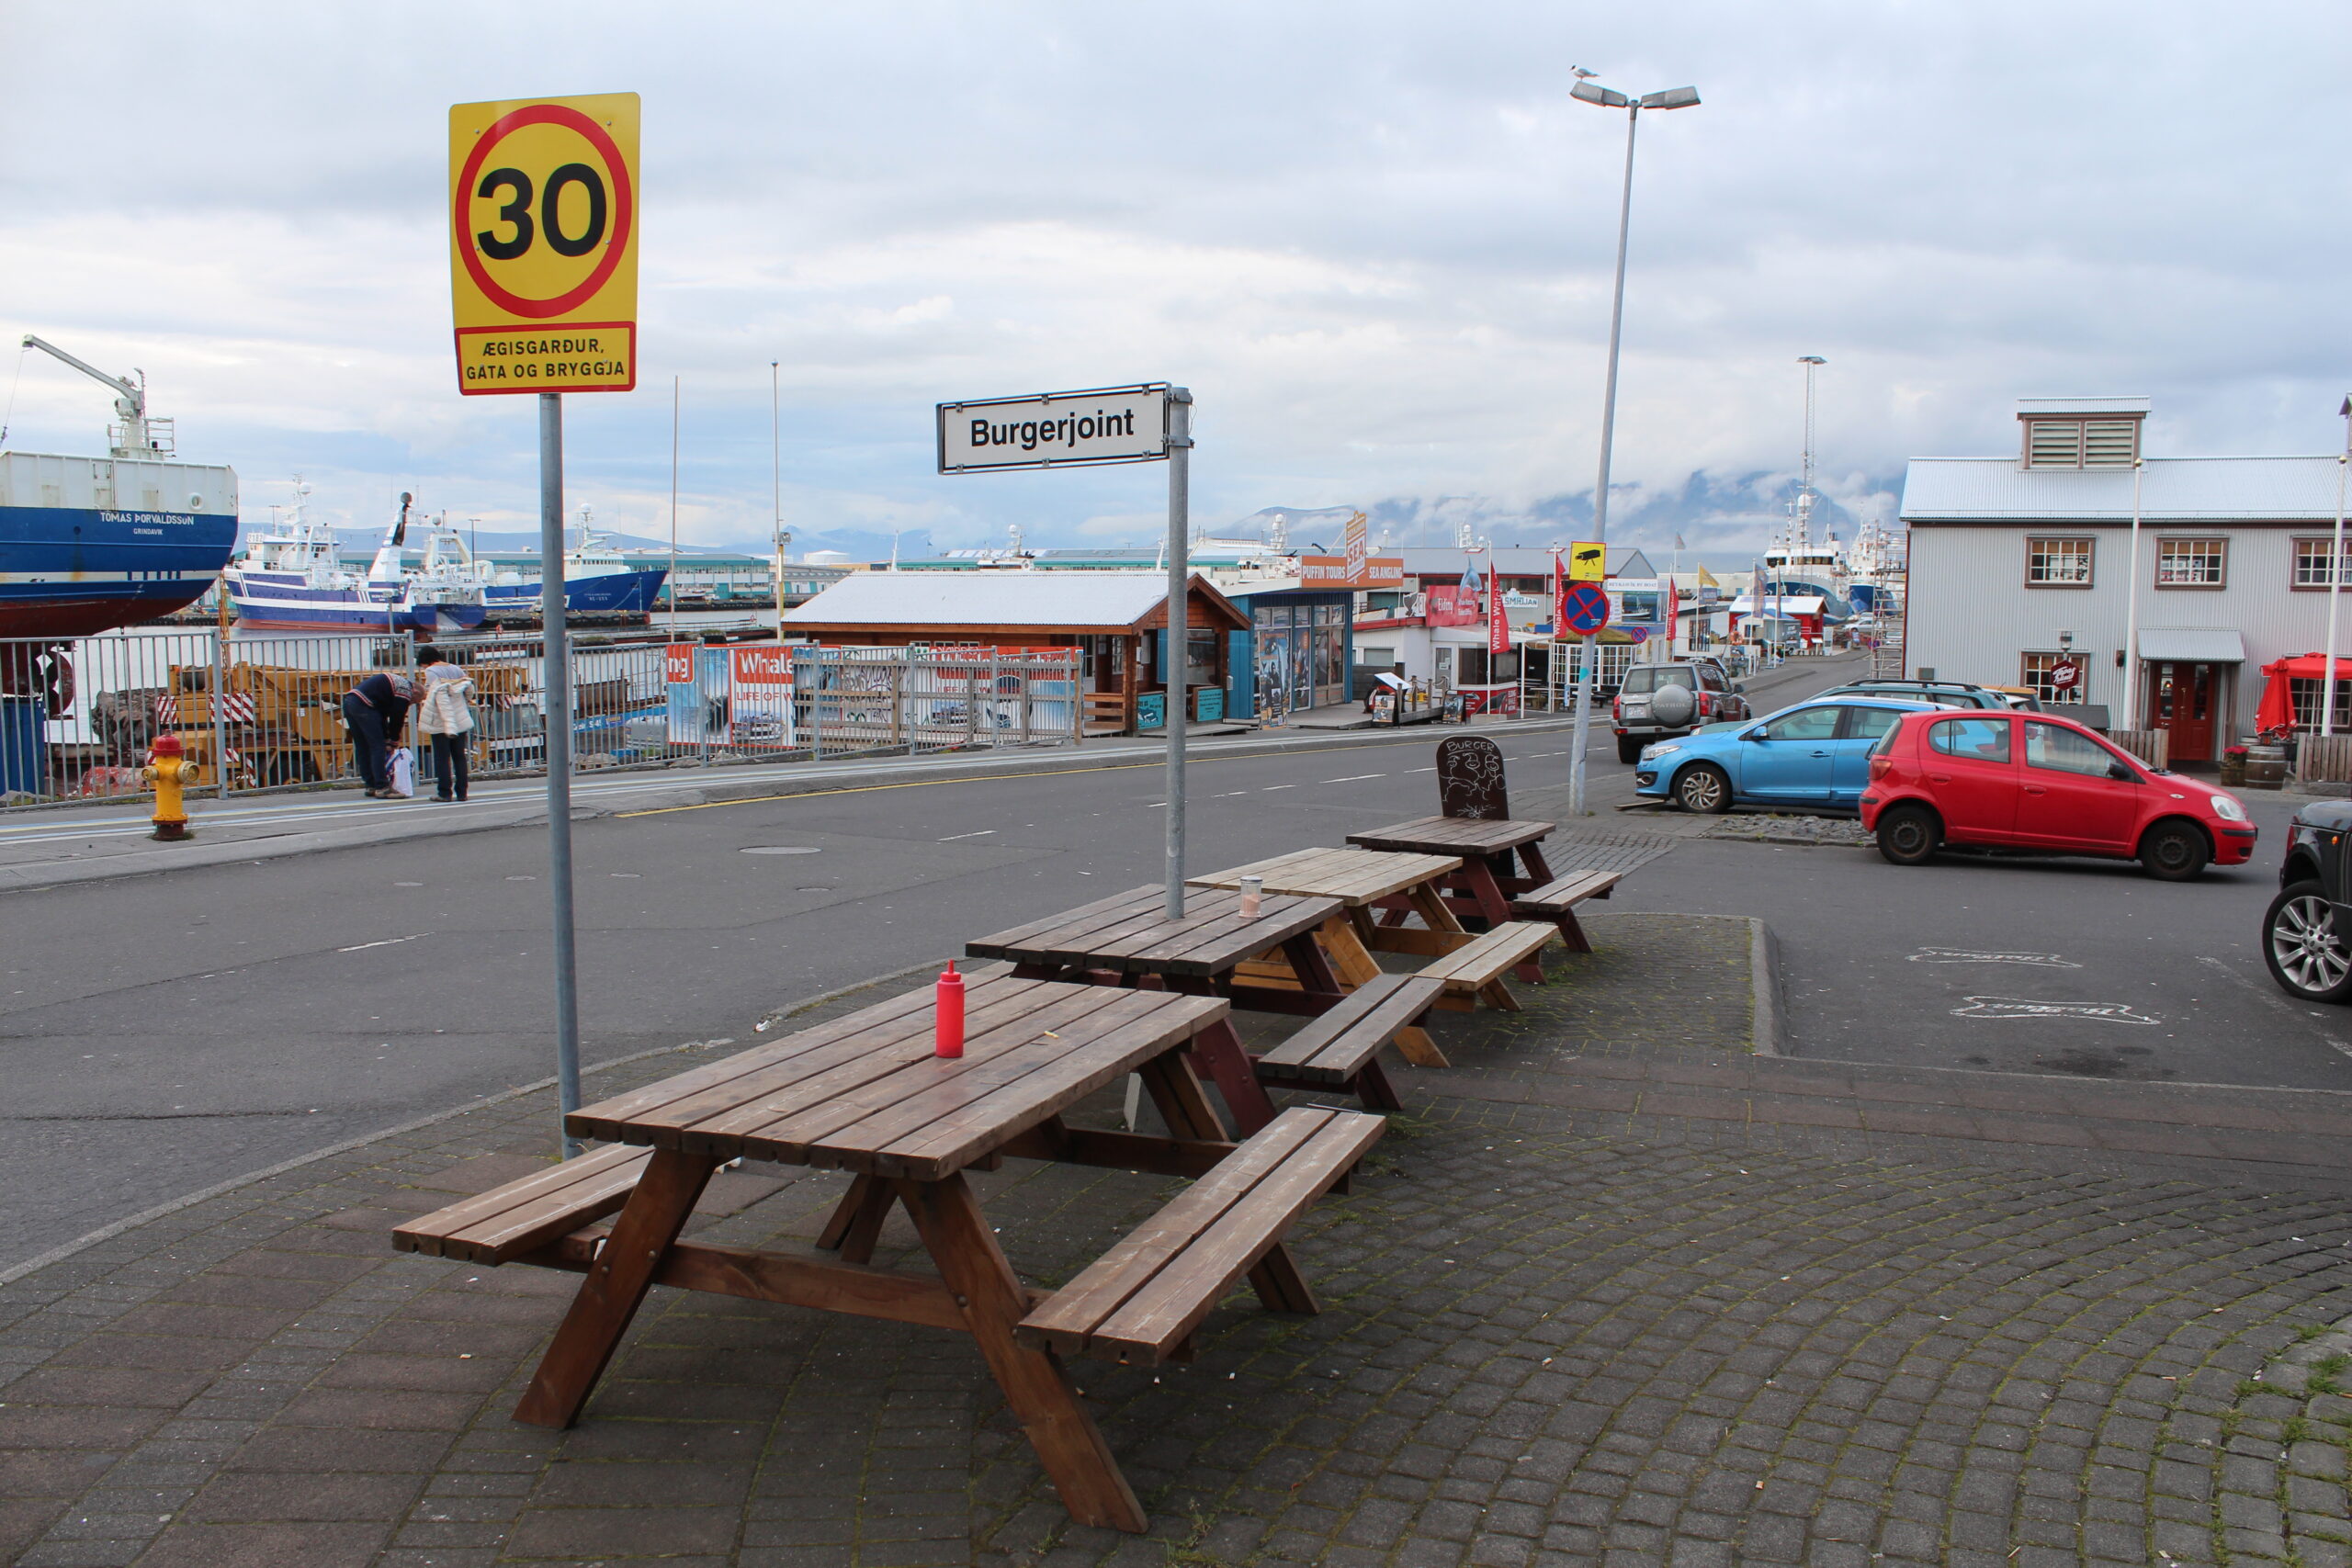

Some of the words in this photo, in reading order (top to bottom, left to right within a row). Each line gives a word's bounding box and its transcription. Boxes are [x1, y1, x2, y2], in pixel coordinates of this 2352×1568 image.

[477, 163, 607, 260] 30
[483, 339, 604, 355] ÆGISGARÐUR,
[467, 365, 506, 379] GATA
[514, 364, 537, 378] OG
[546, 361, 625, 377] BRYGGJA
[970, 408, 1134, 451] Burgerjoint
[1348, 539, 1364, 566] SEA
[1302, 565, 1325, 580] PUFFIN
[1326, 565, 1346, 580] TOURS
[1369, 566, 1380, 579] SEA
[1492, 619, 1500, 650] Whale
[668, 657, 689, 678] ng
[736, 692, 760, 702] LIFE
[763, 692, 779, 702] OF
[1446, 740, 1495, 751] BURGER
